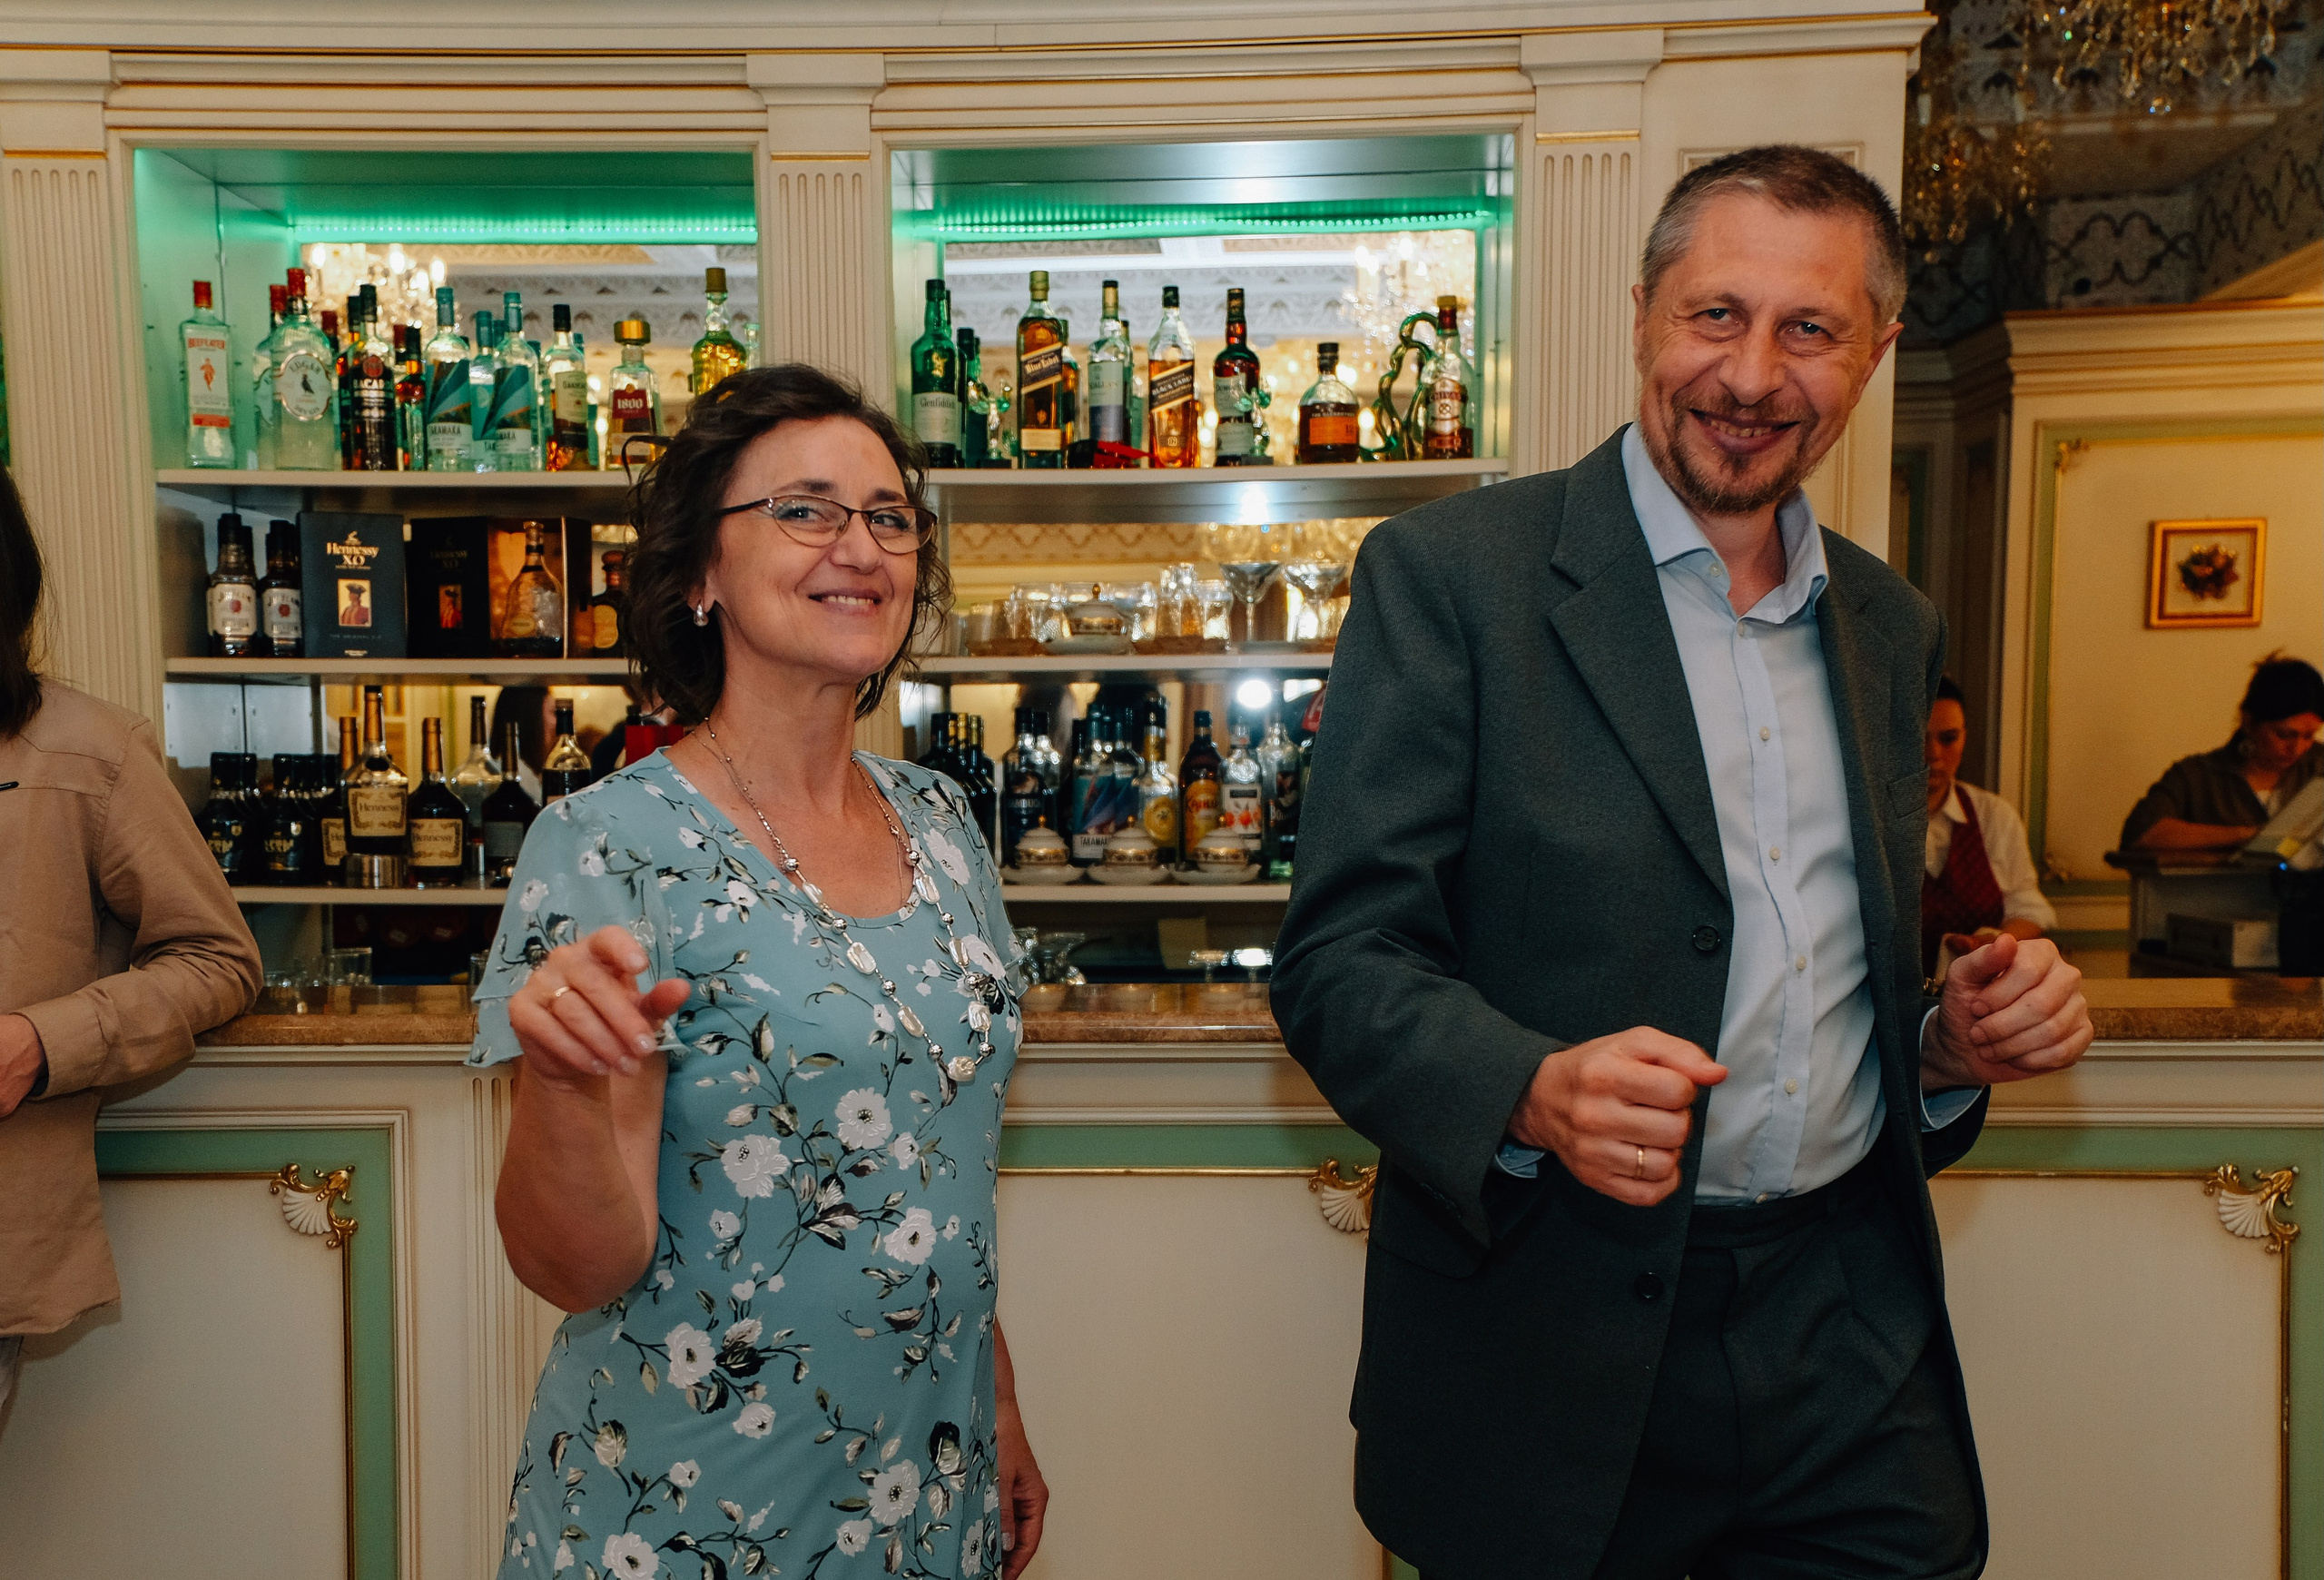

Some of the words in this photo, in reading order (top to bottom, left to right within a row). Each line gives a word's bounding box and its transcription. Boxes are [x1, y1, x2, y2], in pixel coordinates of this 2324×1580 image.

[1025, 362, 1041, 374] Blue
[1040, 355, 1059, 369] Label
[1152, 382, 1173, 395] BLACK
[617, 399, 644, 410] 1800
[327, 542, 379, 558] Hennessy
[343, 554, 366, 566] XO
[359, 803, 400, 813] Hennessy
